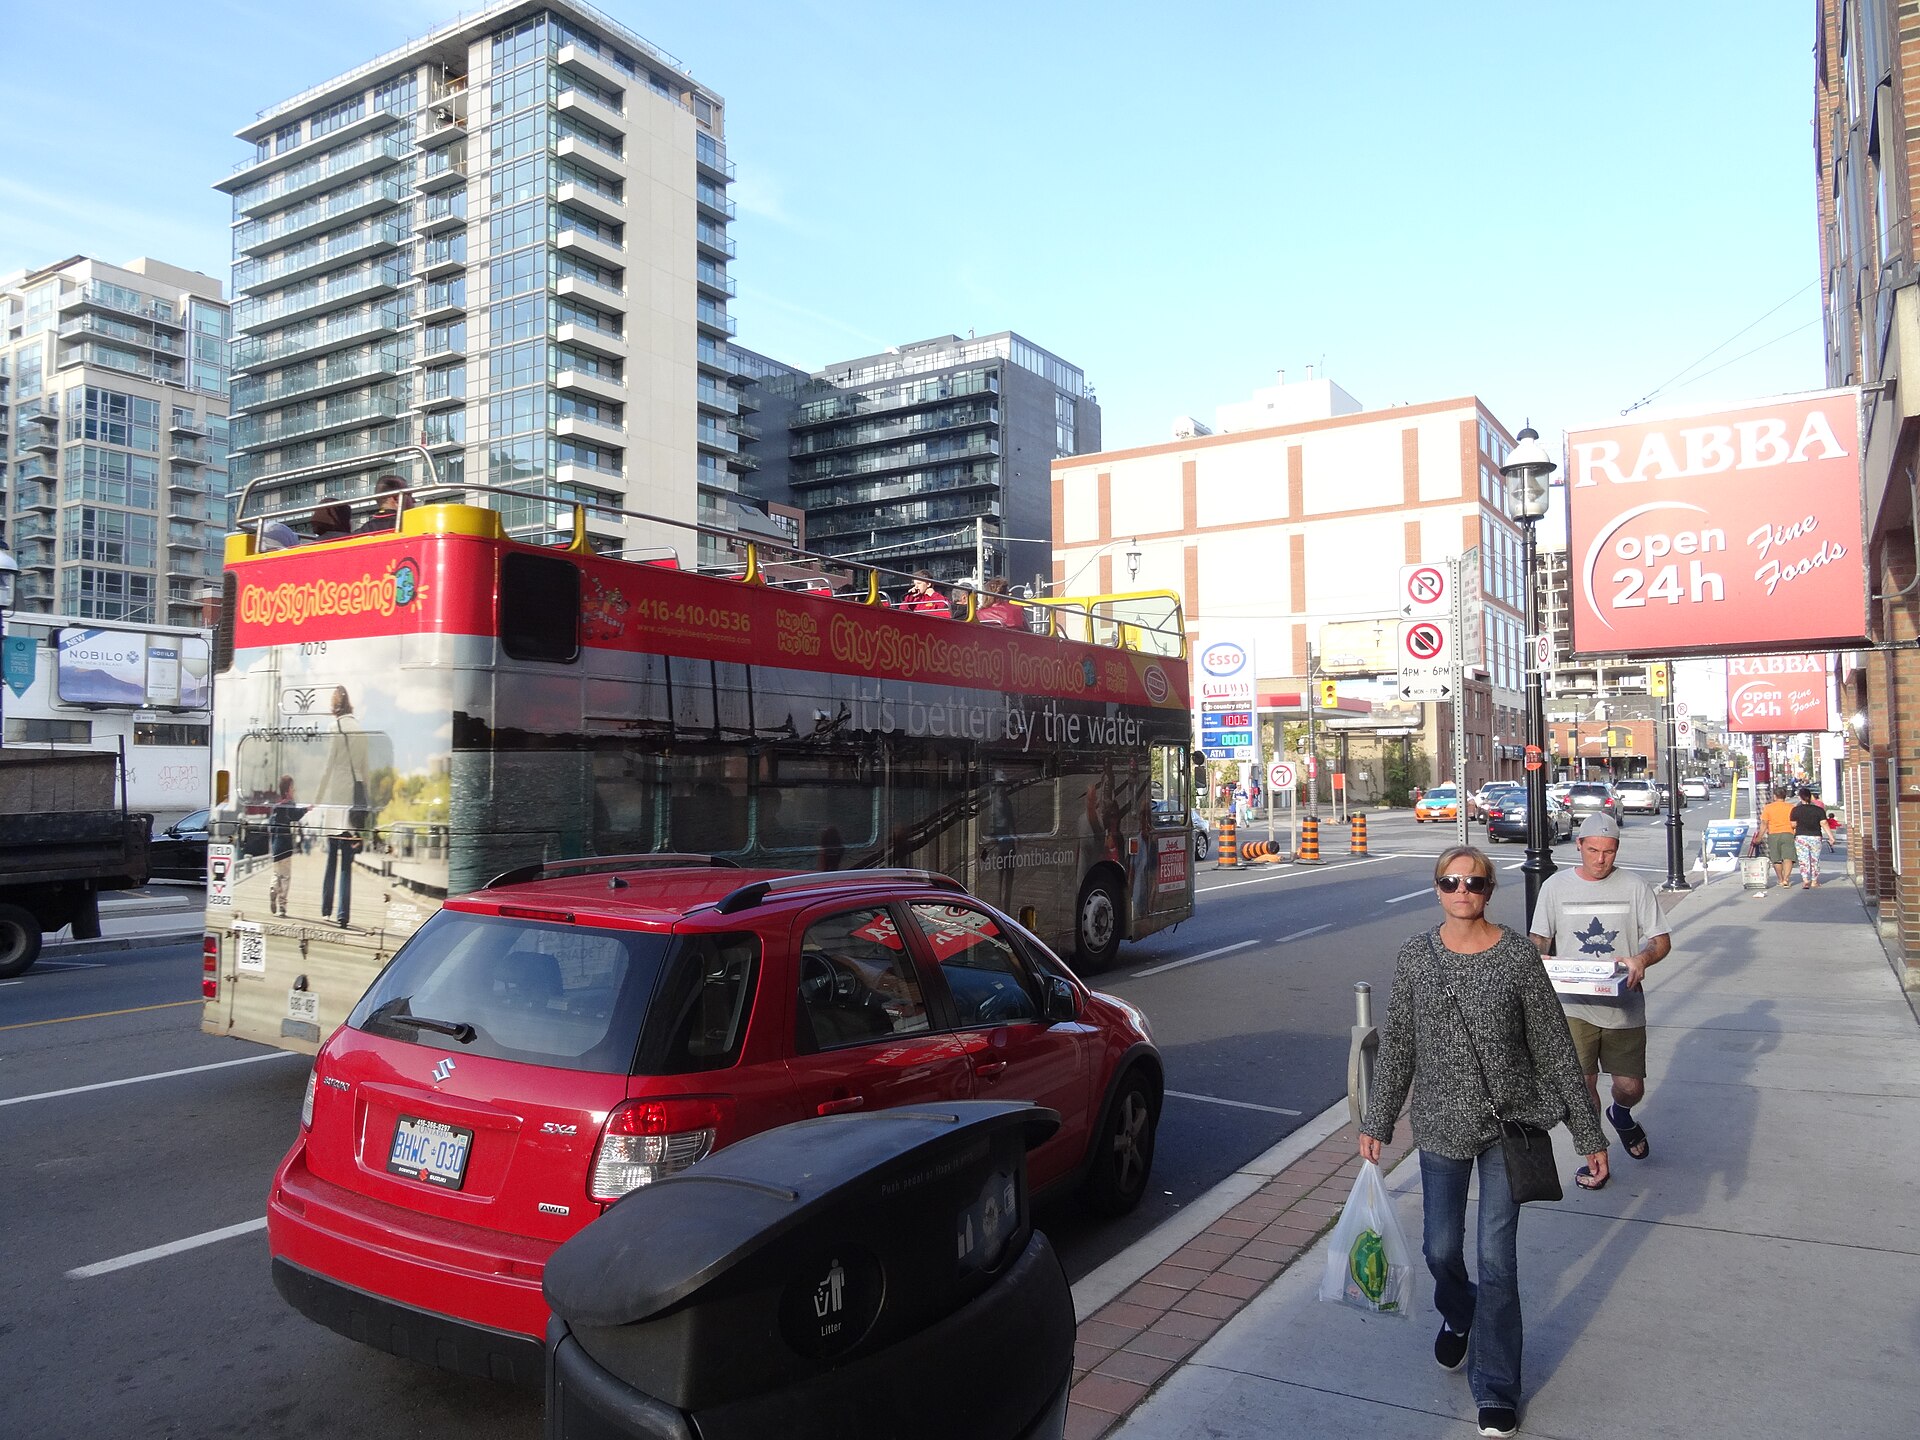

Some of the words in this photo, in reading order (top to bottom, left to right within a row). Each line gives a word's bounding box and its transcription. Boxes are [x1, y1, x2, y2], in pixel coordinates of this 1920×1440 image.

[1573, 410, 1849, 489] RABBA
[1747, 515, 1819, 560] Fine
[1615, 527, 1726, 567] open
[1754, 540, 1849, 597] Foods
[1612, 560, 1725, 609] 24h
[776, 608, 798, 633] Hop
[800, 612, 817, 633] On
[66, 634, 86, 647] NEW
[777, 631, 801, 653] Hop
[801, 635, 821, 656] Off
[69, 650, 123, 662] NOBILO
[299, 641, 328, 657] 7079
[1007, 642, 1085, 694] Toronto
[1402, 667, 1419, 676] 4PM
[1433, 666, 1450, 676] 6PM
[1728, 654, 1822, 676] RABBA
[1742, 690, 1782, 703] open
[1787, 689, 1812, 704] Fine
[1741, 702, 1781, 717] 24h
[1790, 698, 1820, 715] Foods
[851, 685, 896, 734] It's
[907, 692, 997, 742] better
[1005, 695, 1034, 753] by
[1043, 700, 1081, 745] the
[1087, 713, 1147, 747] water.
[1210, 749, 1226, 758] ATM
[1160, 862, 1185, 878] FESTIVAL
[540, 1122, 578, 1136] SX4
[539, 1204, 568, 1215] AWD
[820, 1321, 842, 1337] Litter
